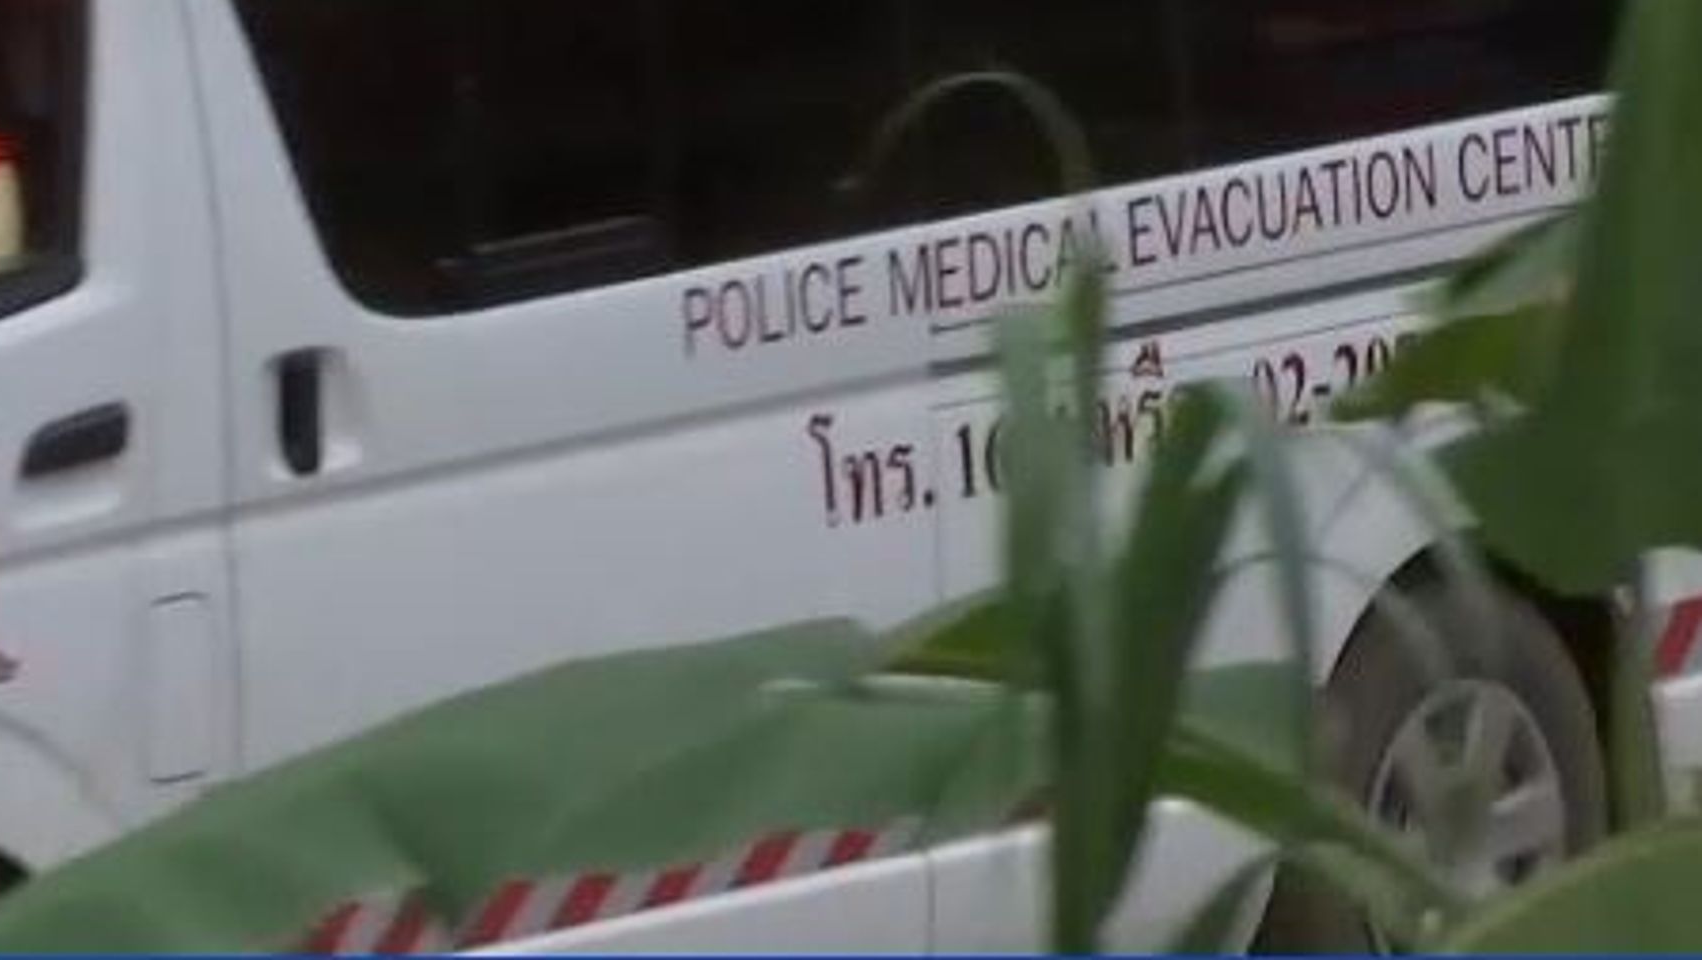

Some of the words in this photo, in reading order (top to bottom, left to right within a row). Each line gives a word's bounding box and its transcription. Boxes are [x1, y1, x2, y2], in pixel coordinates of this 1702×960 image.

[681, 256, 867, 360] POLICE
[1127, 144, 1438, 268] EVACUATION
[807, 414, 935, 528] โทร.
